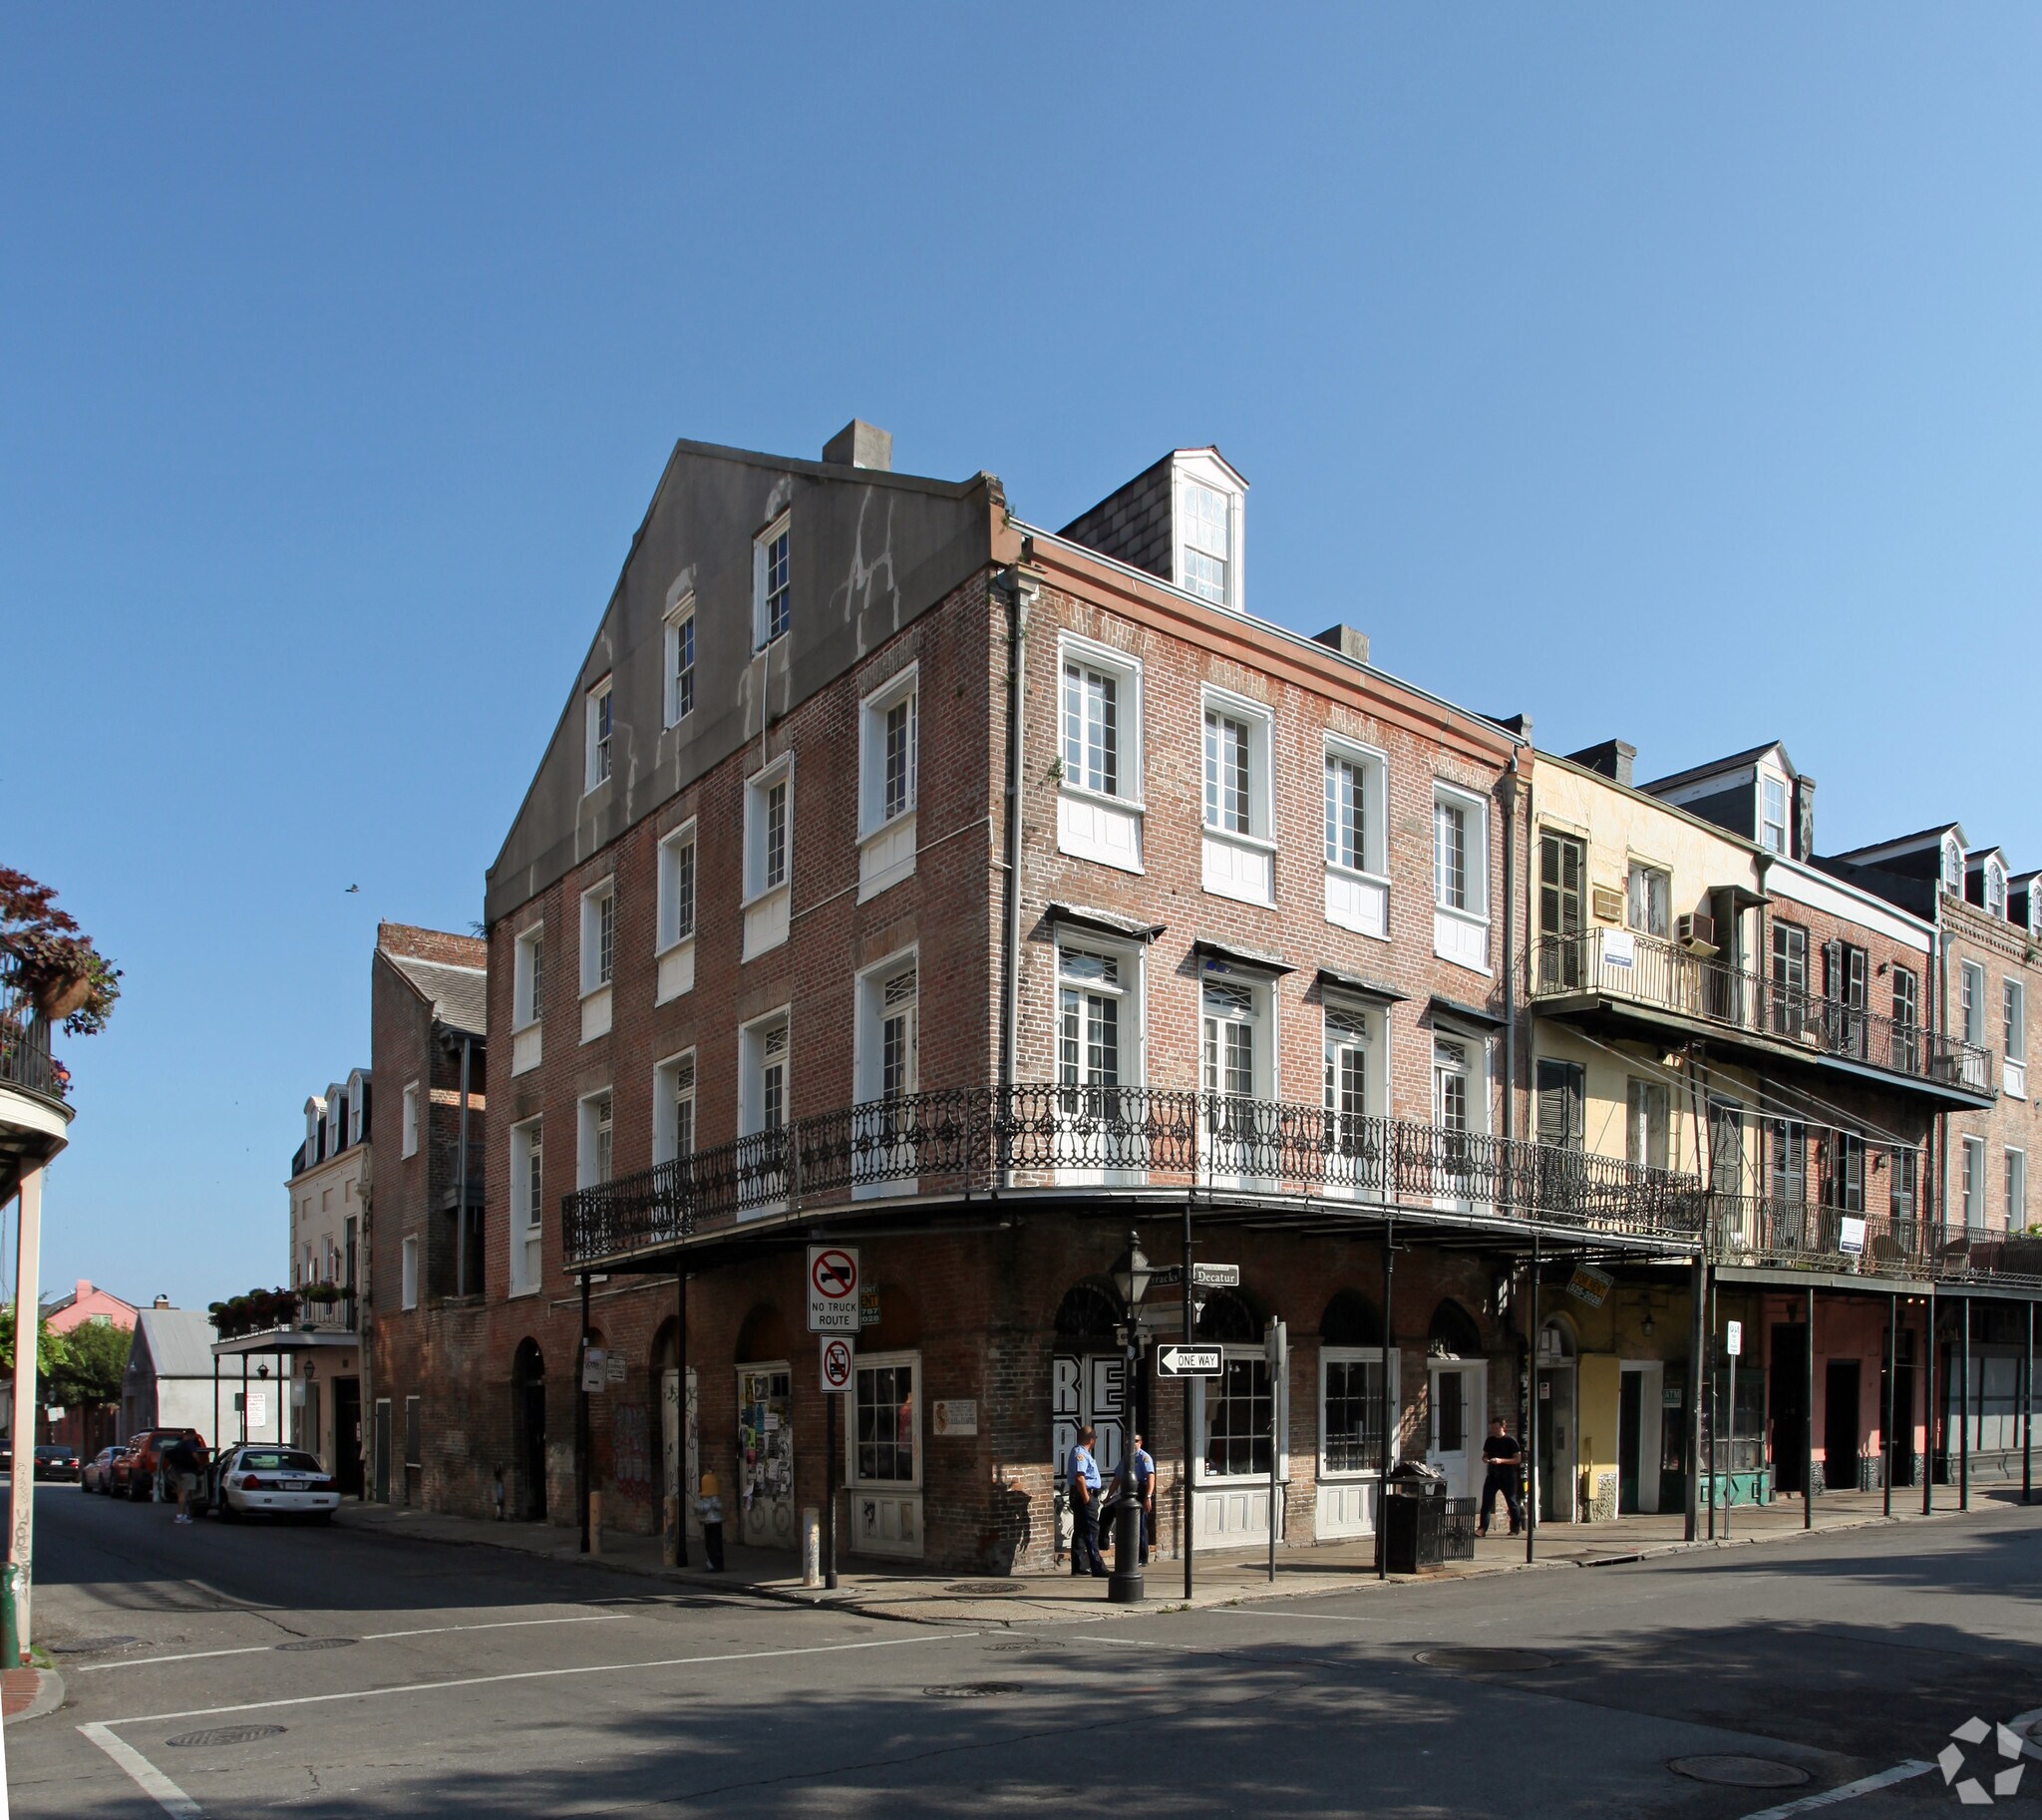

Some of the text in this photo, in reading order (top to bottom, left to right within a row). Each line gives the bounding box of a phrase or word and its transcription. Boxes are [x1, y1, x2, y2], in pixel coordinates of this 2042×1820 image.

[1151, 1272, 1179, 1283] rracks
[1197, 1271, 1235, 1282] Decatur
[861, 1294, 878, 1306] ENT
[812, 1302, 856, 1312] NO TRUCK
[819, 1315, 850, 1325] ROUTE
[1178, 1354, 1215, 1366] ONE WAY
